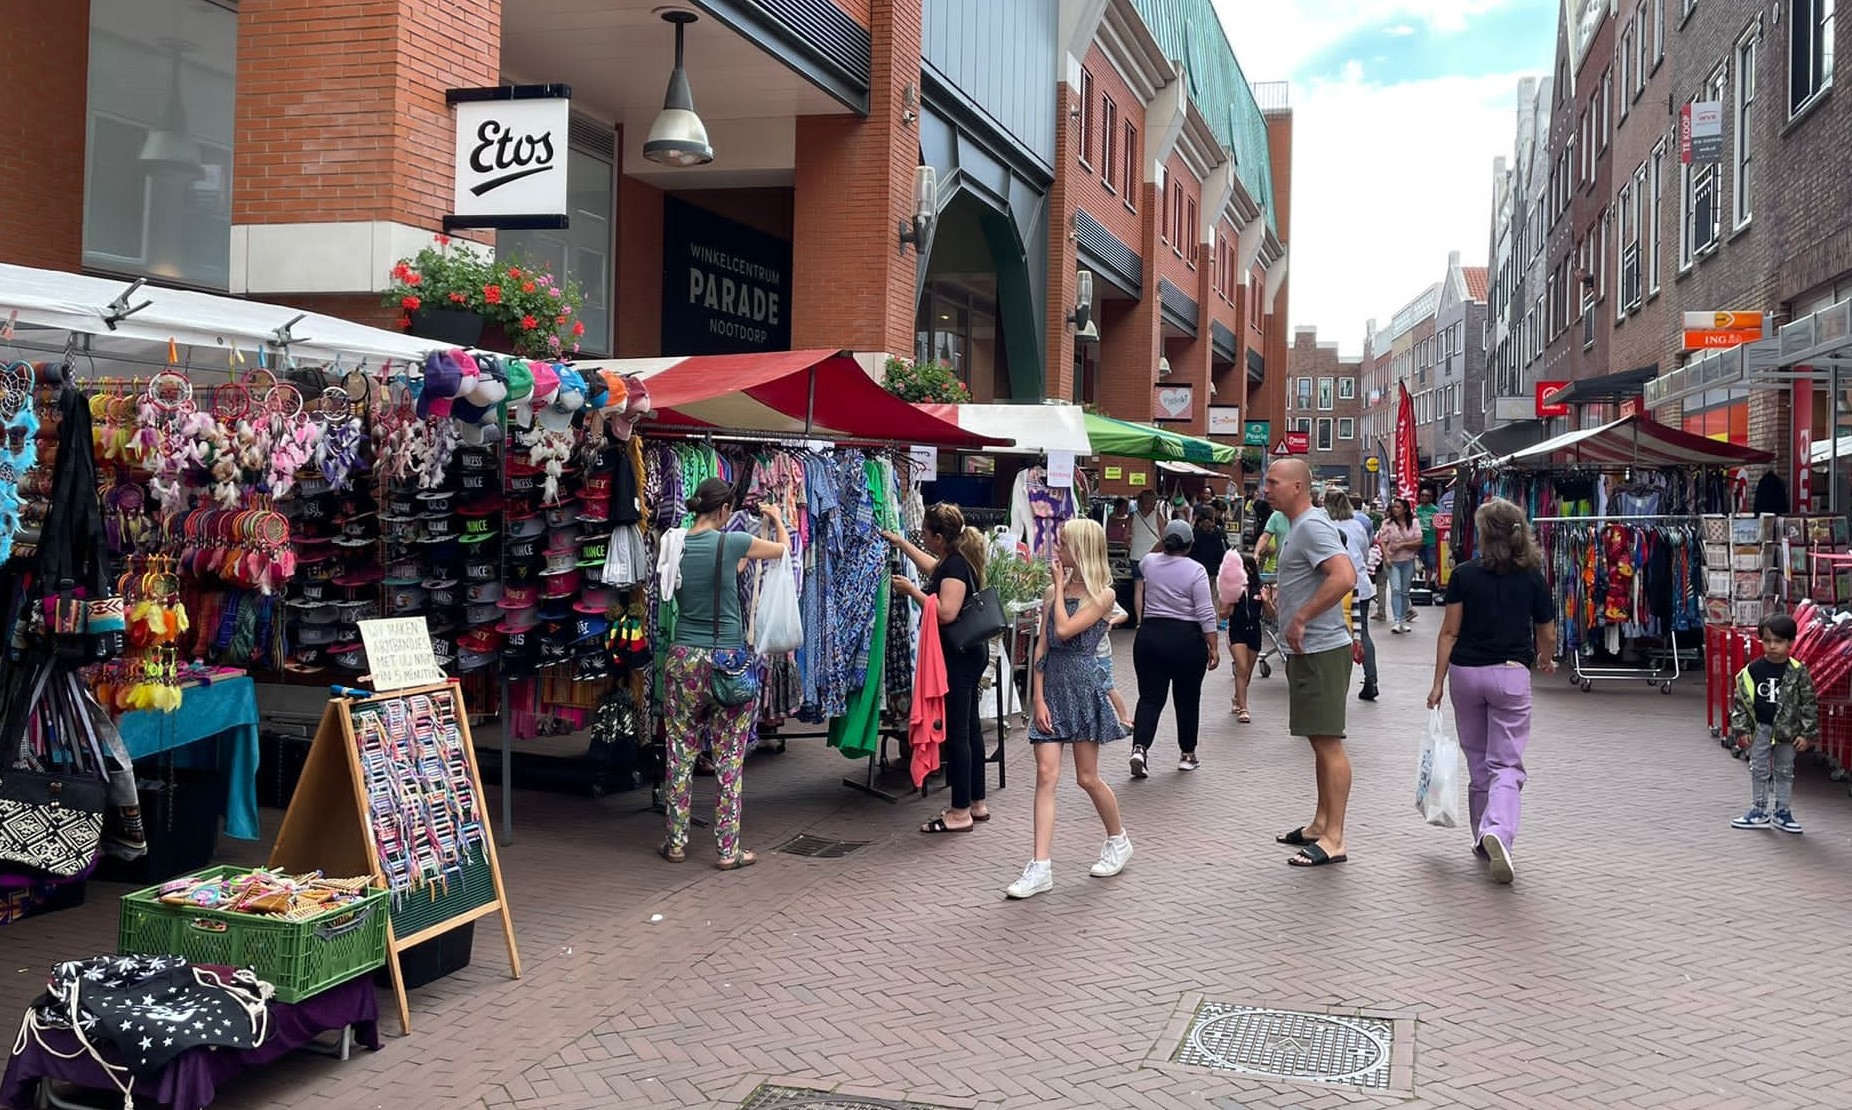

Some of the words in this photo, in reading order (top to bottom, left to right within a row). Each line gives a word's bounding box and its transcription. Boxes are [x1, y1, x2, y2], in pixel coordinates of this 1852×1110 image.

[470, 120, 554, 174] Etos
[1682, 142, 1690, 152] TE
[690, 242, 780, 286] WINKELCENTRUM
[689, 267, 779, 325] PARADE
[709, 318, 768, 343] NOOTDORP
[1704, 335, 1727, 344] ING
